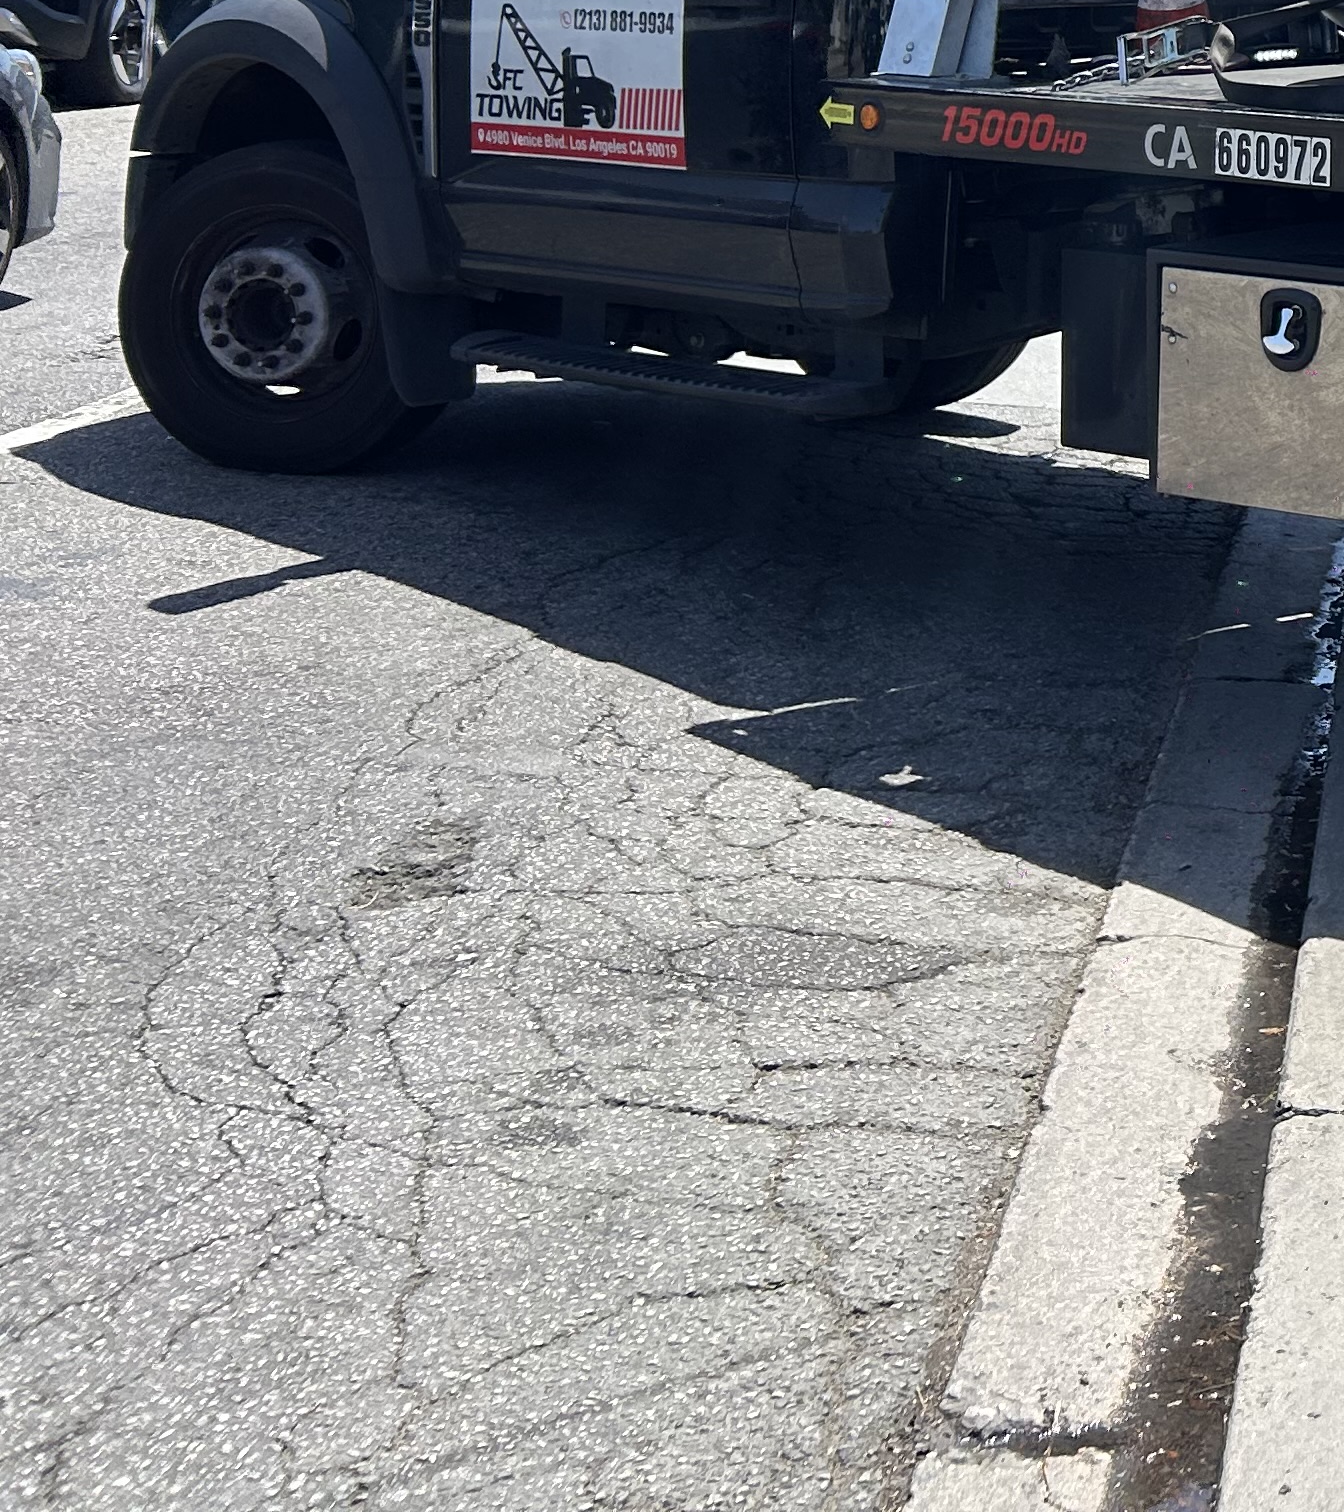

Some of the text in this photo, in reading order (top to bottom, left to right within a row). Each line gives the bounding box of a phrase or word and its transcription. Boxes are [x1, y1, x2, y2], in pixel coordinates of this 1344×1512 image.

[574, 8, 674, 35] (213) 881-9934
[476, 93, 562, 122] TOWING
[512, 132, 543, 148] Venice
[570, 137, 587, 152] Los
[589, 139, 627, 156] Angeles
[629, 142, 644, 156] CA
[646, 144, 677, 159] 90019
[1144, 123, 1329, 185] CA 660972
